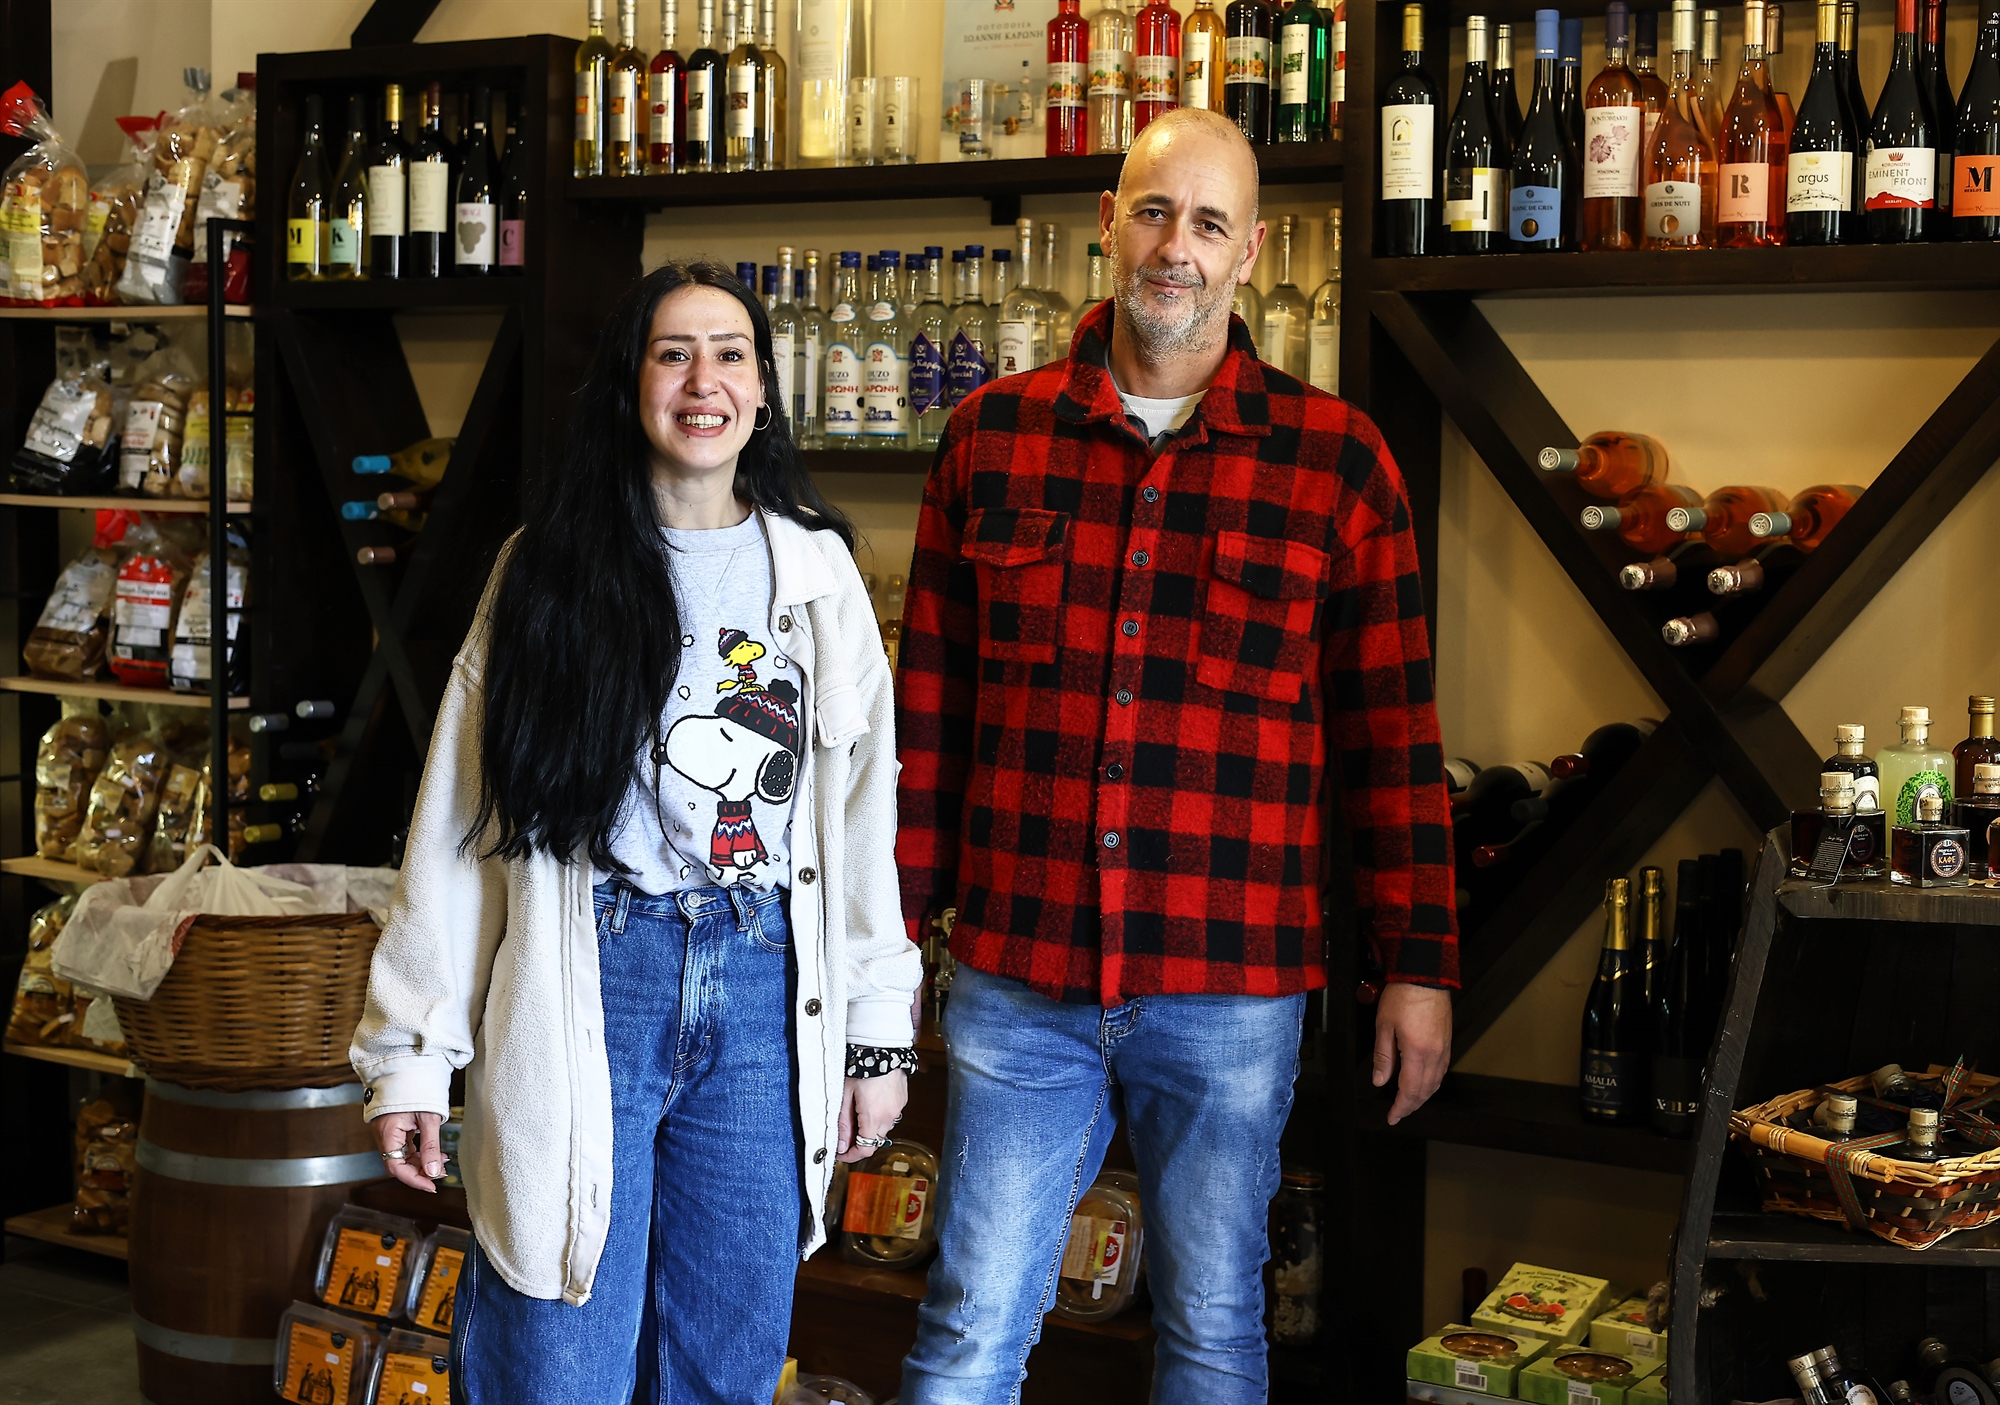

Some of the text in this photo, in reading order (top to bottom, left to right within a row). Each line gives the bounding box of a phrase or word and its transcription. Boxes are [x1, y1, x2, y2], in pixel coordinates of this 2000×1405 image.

[963, 30, 1043, 42] ΙΩΑΝΝΗ ΚΑΡΩΝΗ
[1797, 174, 1829, 185] argus
[1868, 169, 1909, 179] EMINENT
[1965, 166, 1995, 192] M
[1731, 174, 1750, 198] R
[1894, 177, 1927, 186] FRONT
[1938, 855, 1957, 864] ΚΑΦΕ
[1584, 1073, 1618, 1087] AMALIA
